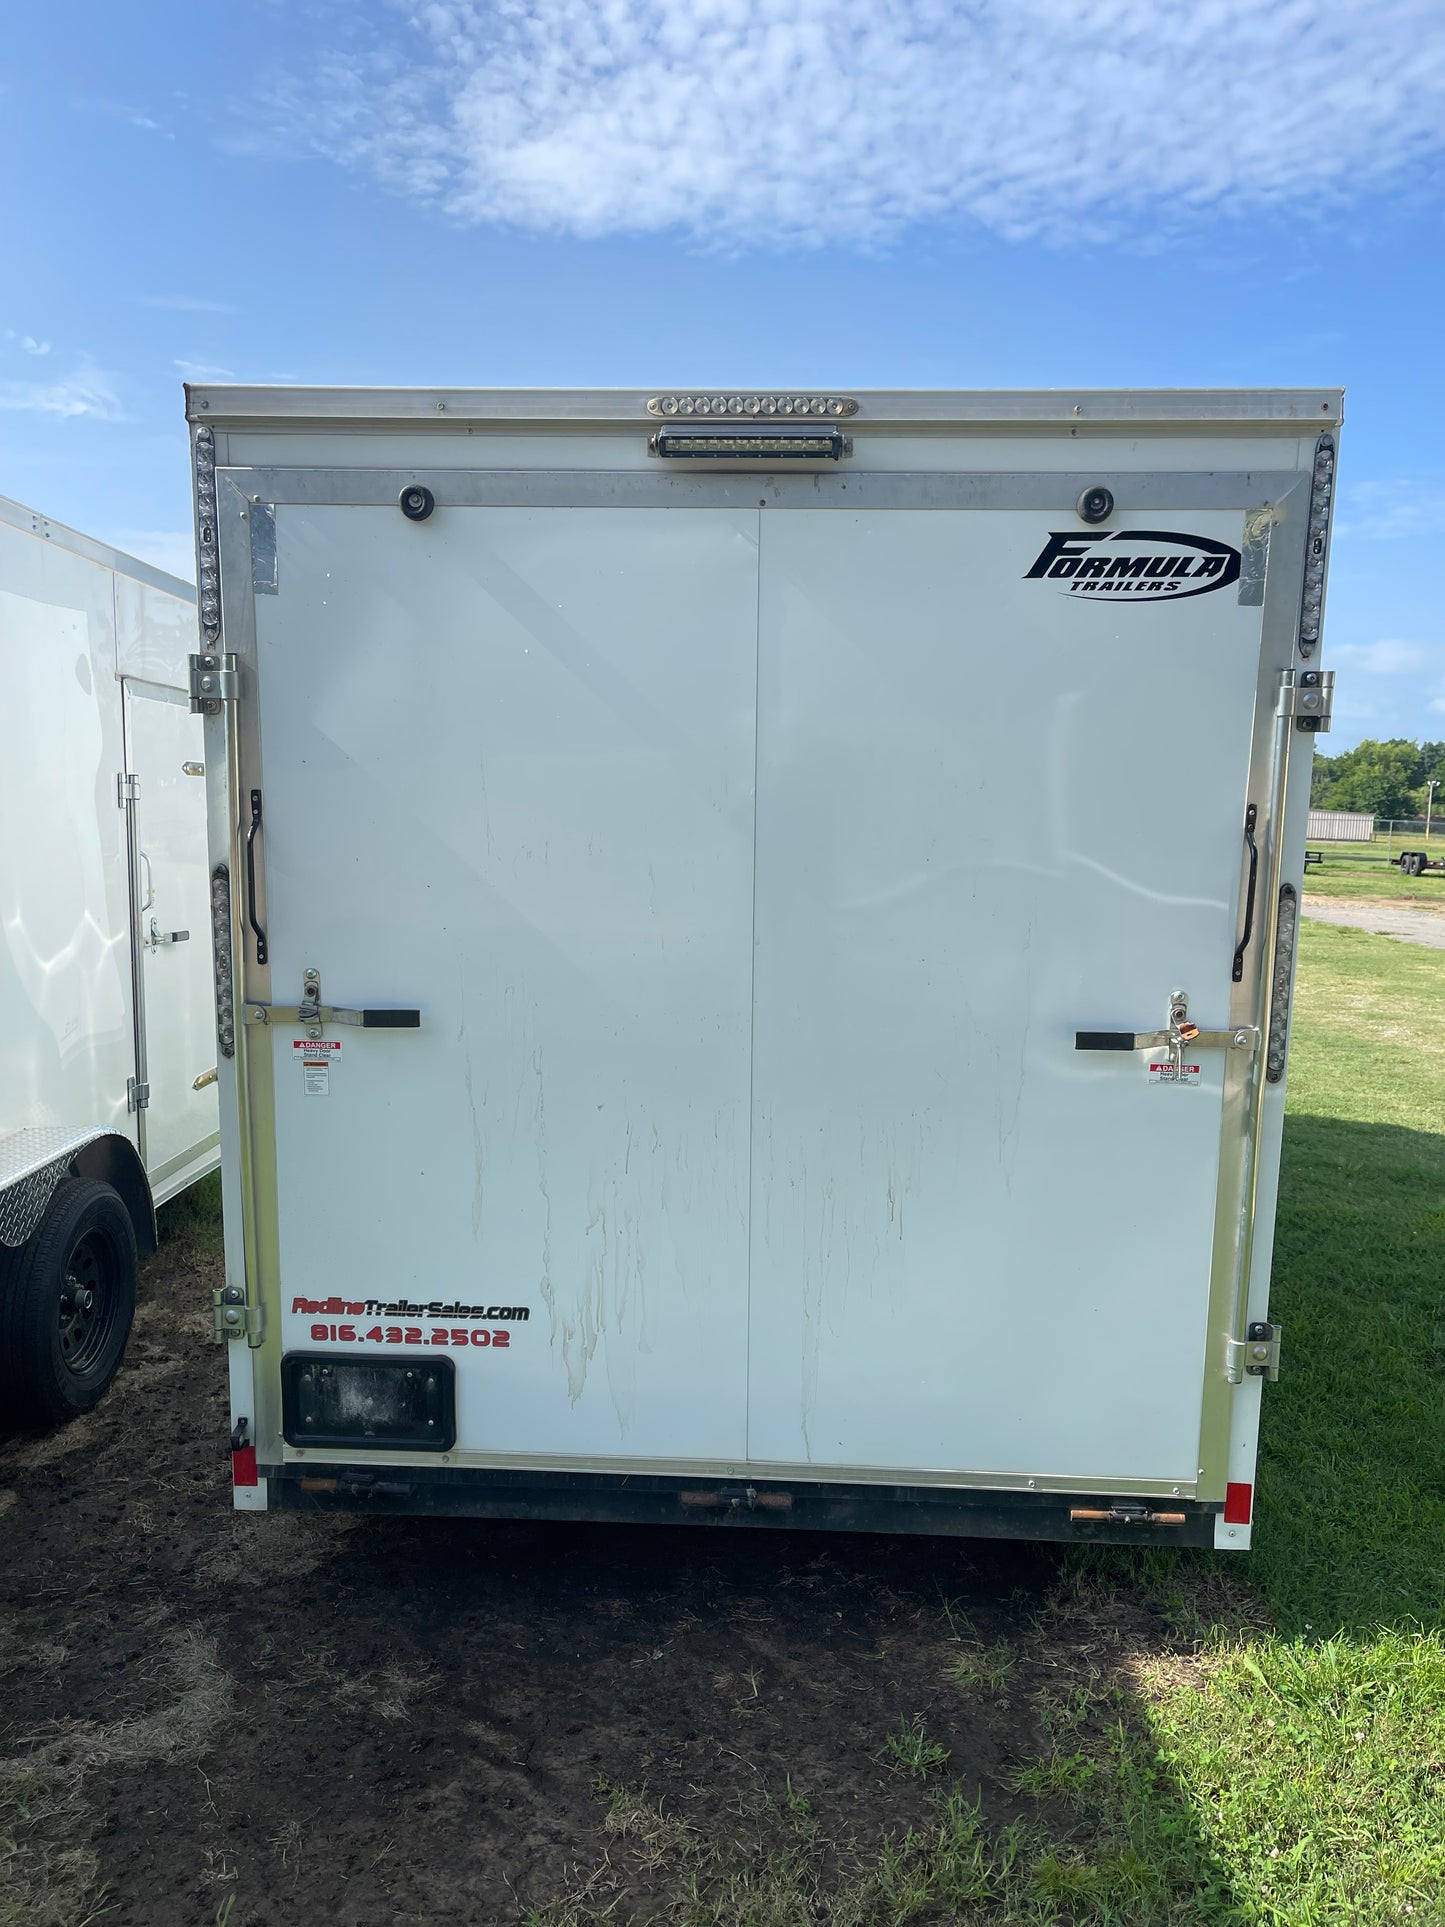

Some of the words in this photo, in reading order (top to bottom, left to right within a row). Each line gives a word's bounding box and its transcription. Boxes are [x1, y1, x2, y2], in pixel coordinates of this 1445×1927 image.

[1021, 531, 1229, 579] FORMULA
[1070, 581, 1181, 592] TRAILERS
[292, 1297, 530, 1321] RedlineTrailerSales.com
[310, 1325, 510, 1347] 816.432.2502
